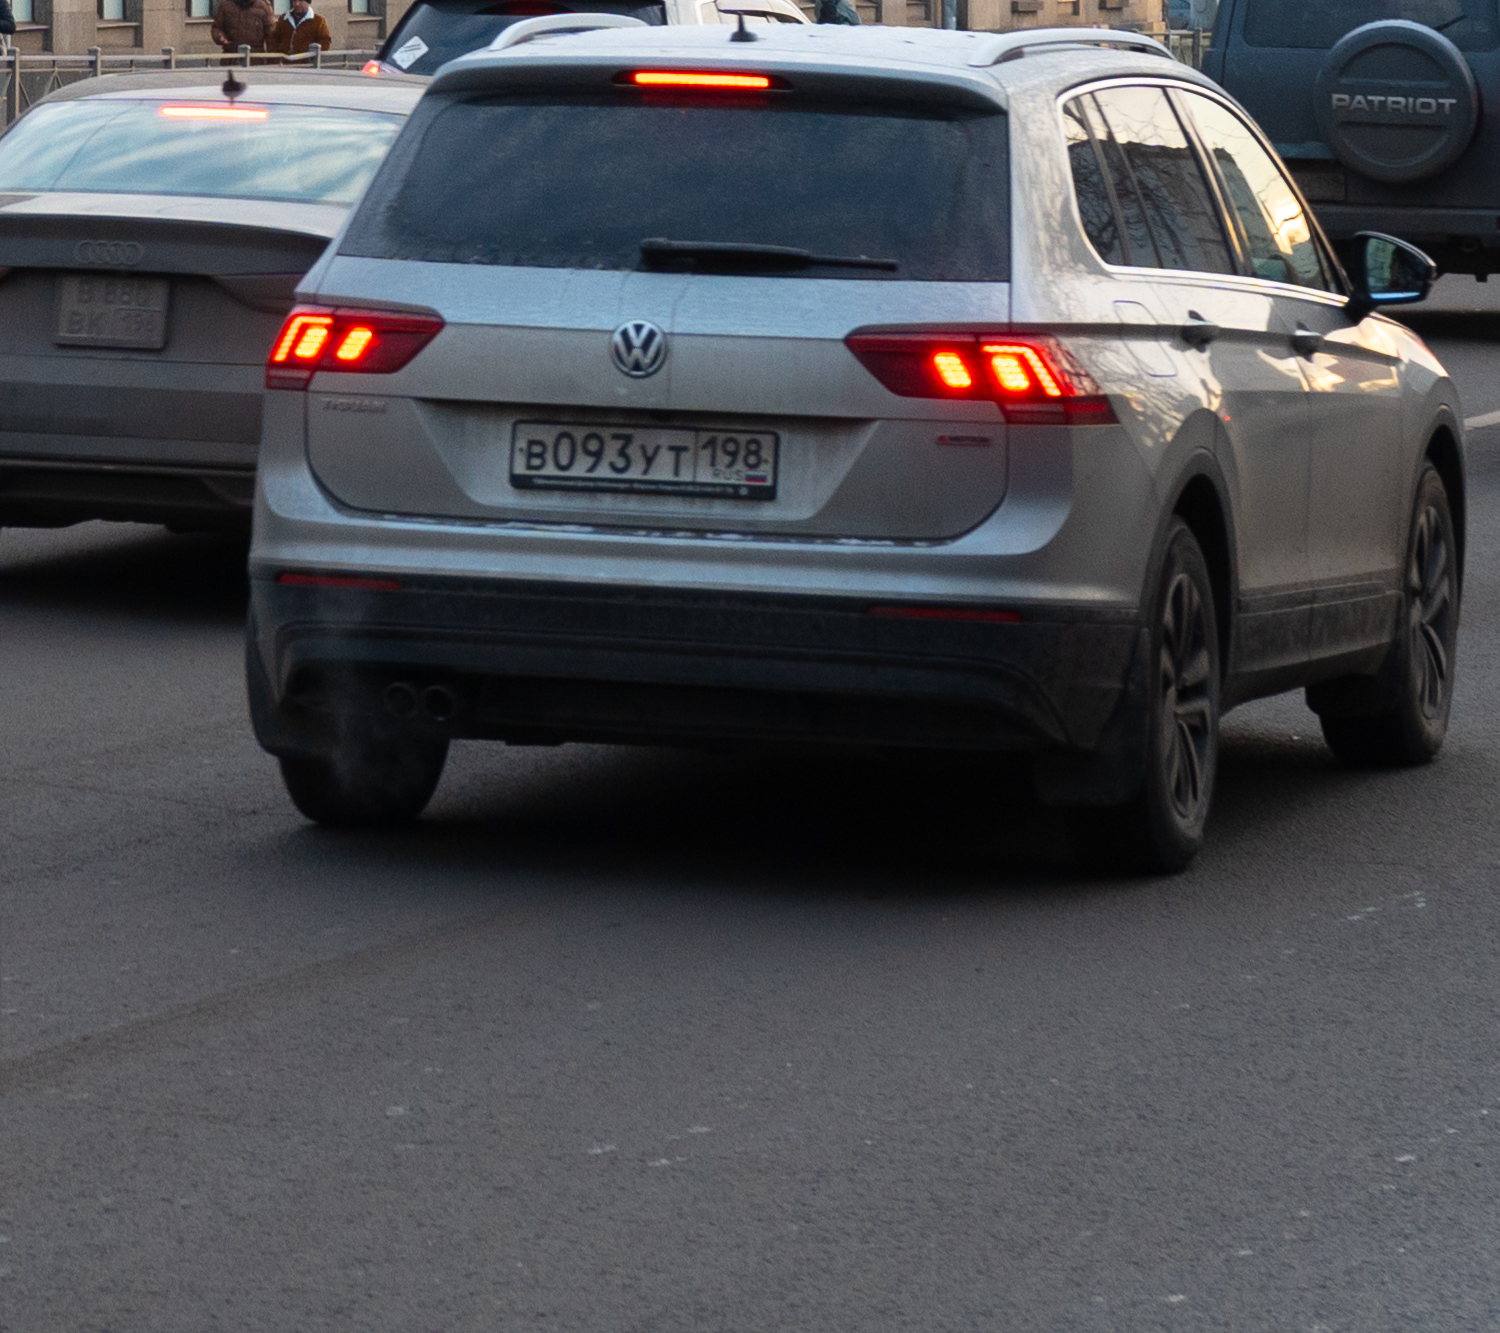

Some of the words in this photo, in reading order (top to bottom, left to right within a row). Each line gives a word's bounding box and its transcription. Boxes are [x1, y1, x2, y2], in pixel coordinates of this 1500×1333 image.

[1331, 93, 1457, 115] PATRIOT
[525, 431, 690, 477] В093УТ
[701, 436, 763, 469] 198
